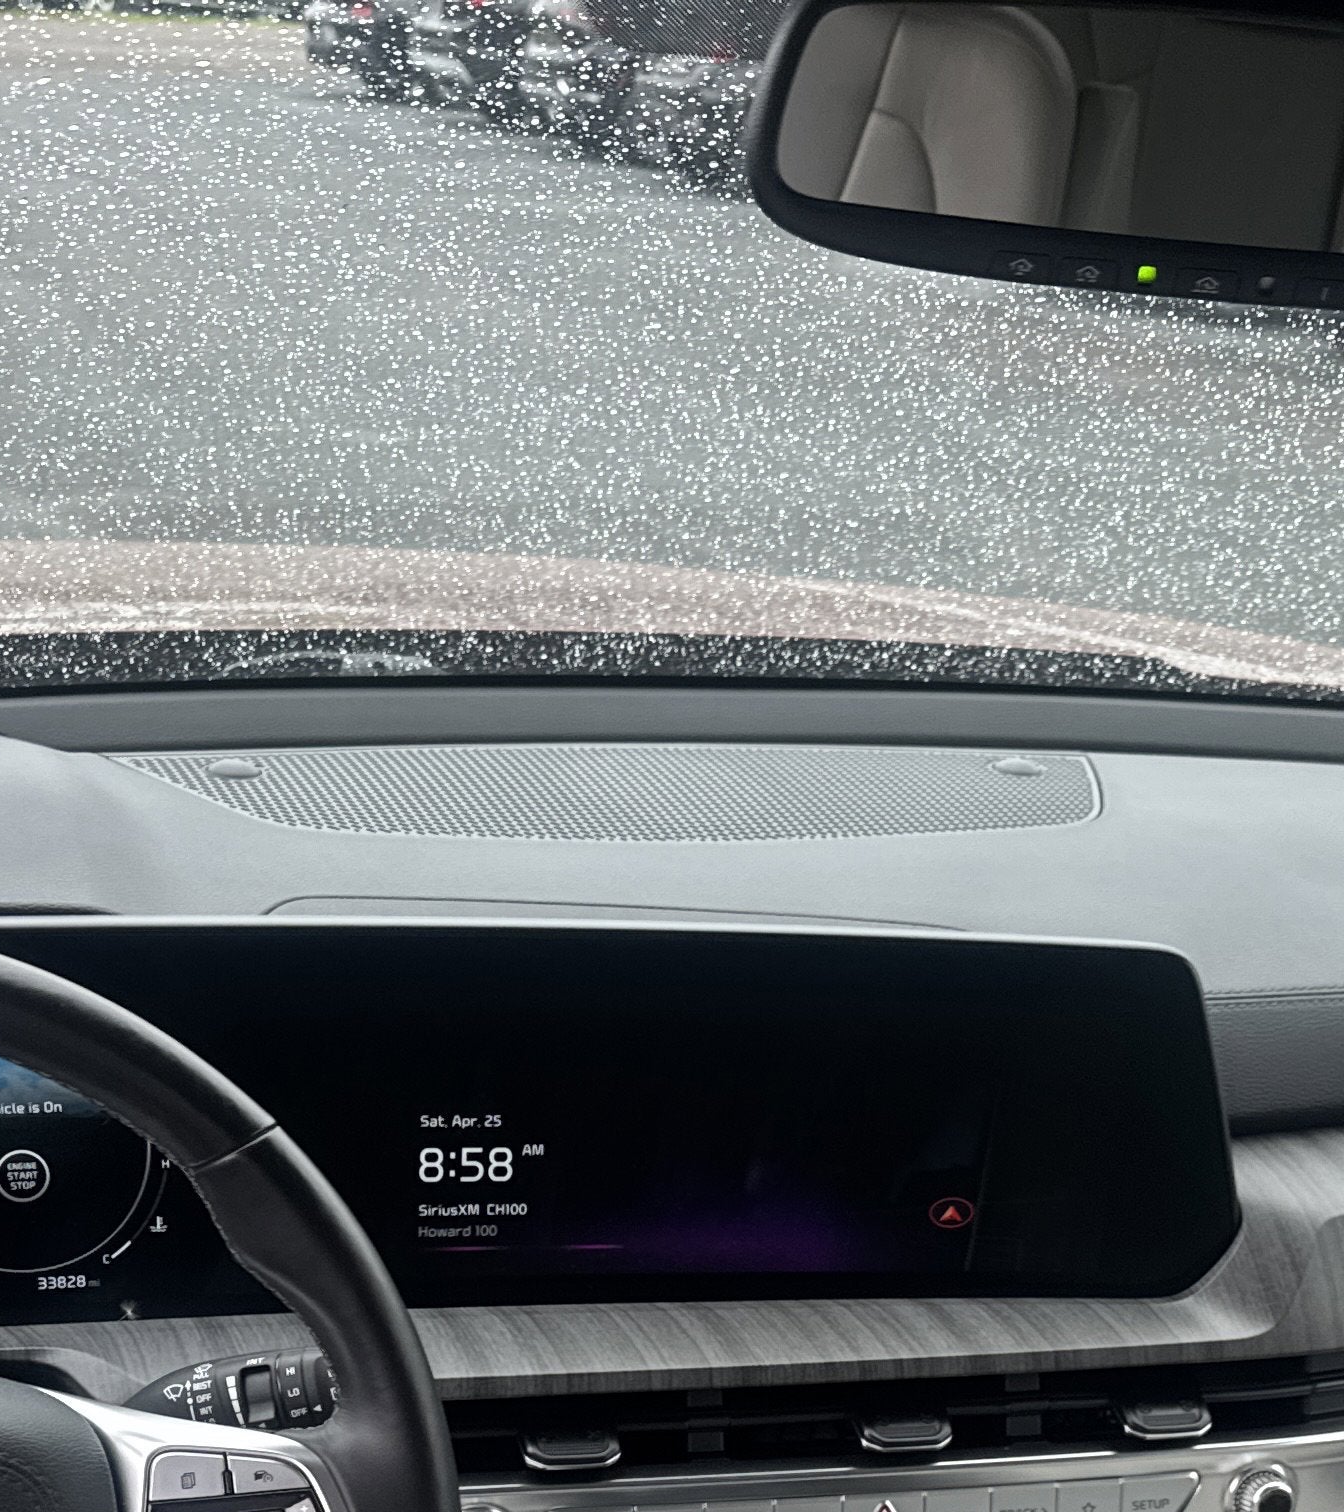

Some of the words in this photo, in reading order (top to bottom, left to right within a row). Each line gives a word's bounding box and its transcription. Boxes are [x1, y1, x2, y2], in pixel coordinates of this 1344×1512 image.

[28, 1102, 40, 1114] is
[43, 1101, 63, 1114] On
[420, 1115, 448, 1128] Sat.
[452, 1115, 481, 1129] Apr.
[484, 1114, 502, 1128] 25
[7, 1161, 37, 1170] ENGINE
[161, 1159, 171, 1169] H
[419, 1147, 513, 1183] 8:58
[522, 1144, 545, 1156] AM
[7, 1170, 38, 1181] START
[10, 1180, 36, 1190] STOP
[418, 1203, 480, 1217] SiriusXM
[486, 1203, 528, 1216] CH100
[418, 1225, 472, 1238] Howard
[475, 1225, 498, 1237] 100
[102, 1253, 110, 1264] C
[37, 1275, 86, 1290] 33828
[285, 1366, 296, 1376] HI
[196, 1393, 212, 1404] OFF
[287, 1388, 300, 1398] LO
[290, 1408, 308, 1418] OFF
[1131, 1497, 1170, 1512] SETUP
